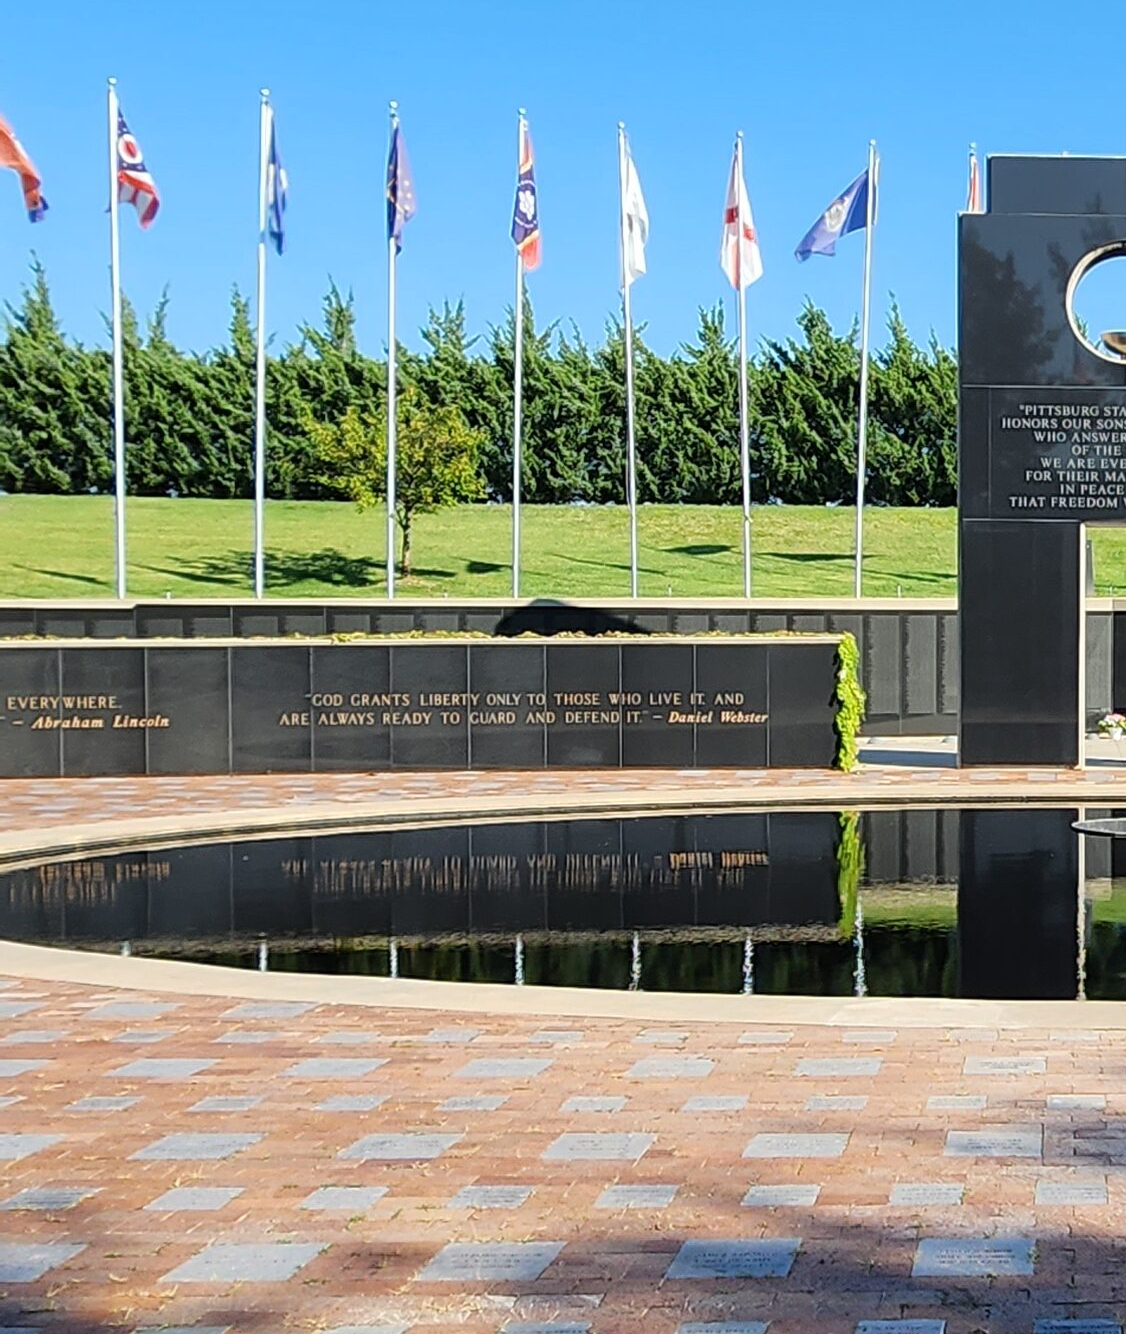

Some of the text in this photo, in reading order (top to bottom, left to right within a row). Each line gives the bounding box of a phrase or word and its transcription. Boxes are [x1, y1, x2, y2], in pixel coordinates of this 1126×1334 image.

[1001, 418, 1057, 431] HONORS
[1062, 418, 1092, 431] OUR
[1034, 431, 1066, 444] WHO
[1072, 445, 1089, 457] OF
[1094, 445, 1120, 457] THE
[1041, 457, 1061, 470] WE
[1067, 457, 1095, 470] ARE
[1026, 471, 1052, 483] FOR
[1057, 471, 1098, 483] THEIR
[1061, 483, 1075, 496] IN
[1081, 483, 1124, 496] PEACE
[1009, 497, 1046, 509] THAT
[1051, 497, 1117, 509] FREEDOM
[351, 693, 410, 707] GRANTS
[420, 693, 480, 707] LIBERTY
[486, 693, 520, 707] ONLY
[527, 693, 546, 706] TO
[554, 693, 600, 705] THOSE
[608, 693, 642, 705] WHO
[650, 693, 682, 705] LIVE
[715, 693, 744, 705] AND
[32, 715, 170, 729] Abraham Lincoln
[279, 713, 310, 726] ARE
[318, 712, 374, 725] ALWAYS
[383, 712, 432, 725] READY
[440, 711, 460, 725] TO
[469, 711, 516, 725] GUARD
[526, 711, 556, 725] AND
[565, 711, 620, 724] DEFEND
[668, 711, 712, 723] Daniel
[720, 711, 769, 724] Webster
